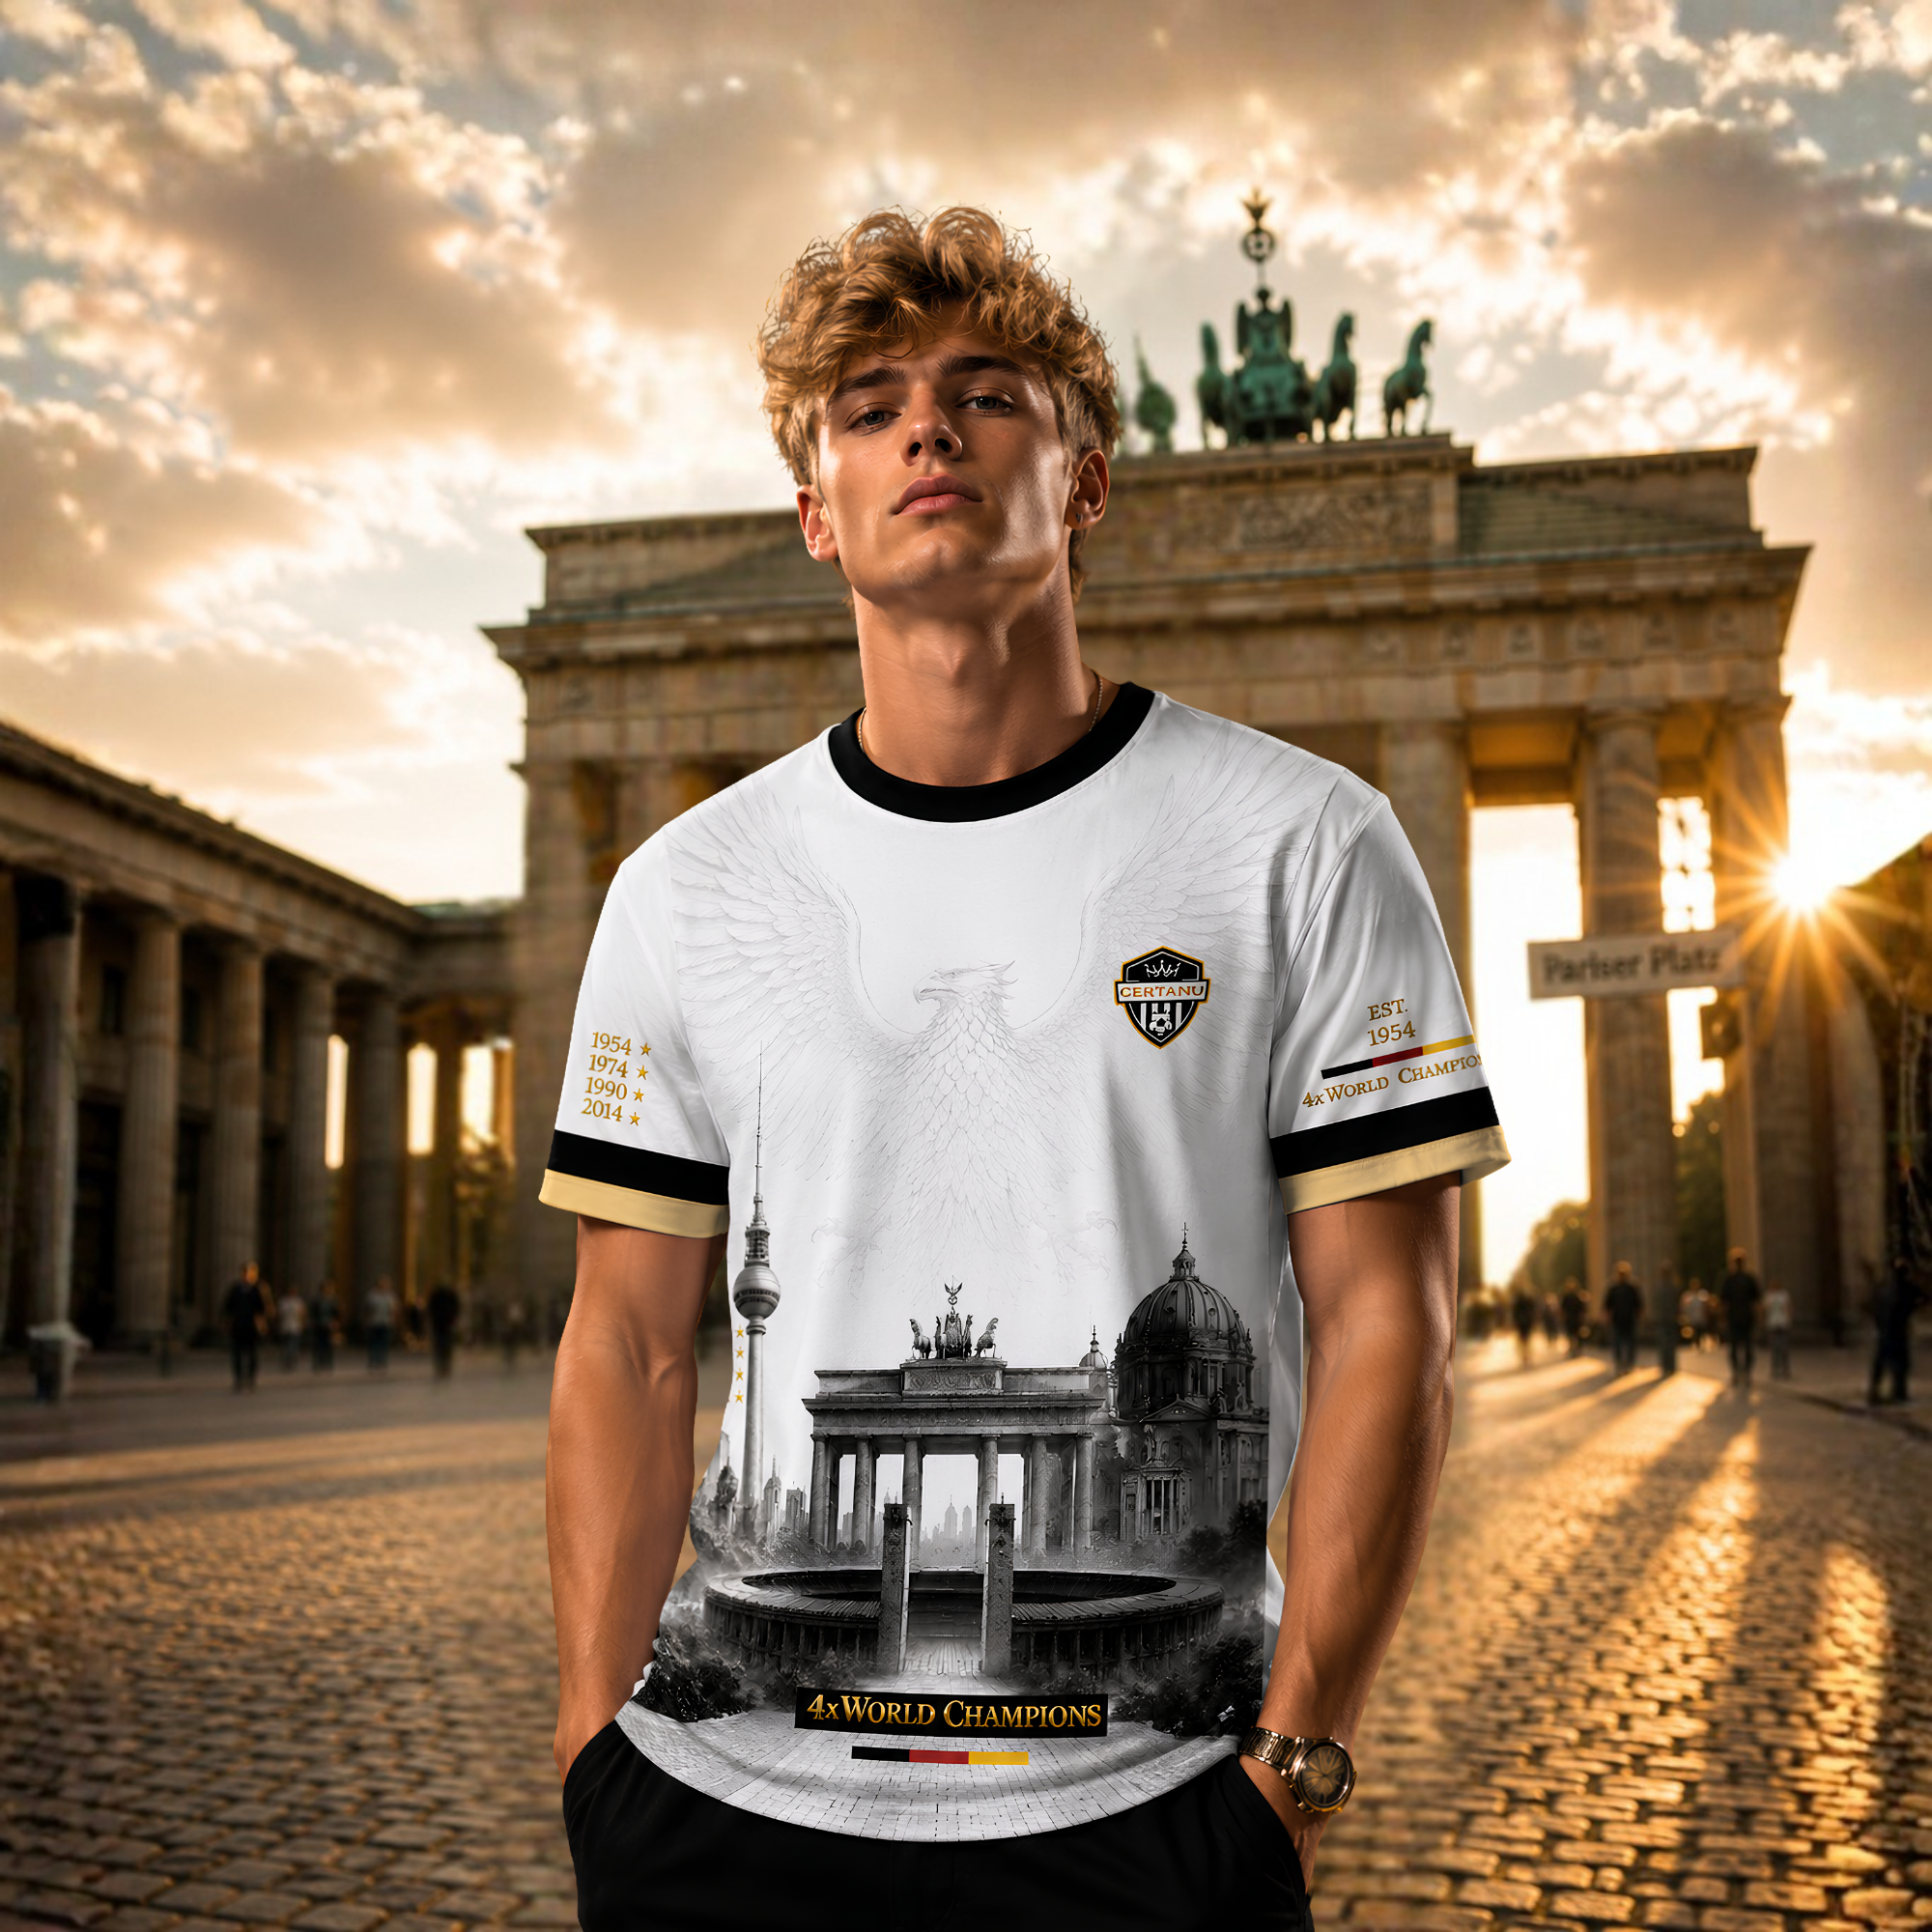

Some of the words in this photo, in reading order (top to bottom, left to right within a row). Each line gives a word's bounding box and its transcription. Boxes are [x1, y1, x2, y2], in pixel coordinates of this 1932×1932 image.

[1649, 944, 1720, 978] Platz
[1120, 985, 1205, 998] CERTANU
[1367, 998, 1408, 1022] EST.
[590, 1031, 632, 1056] 1954
[1367, 1020, 1416, 1047] 1954
[588, 1054, 629, 1079] 1974
[584, 1076, 628, 1100] 1990
[581, 1097, 623, 1122] 2014
[943, 1699, 1103, 1728] CHAMPIONS
